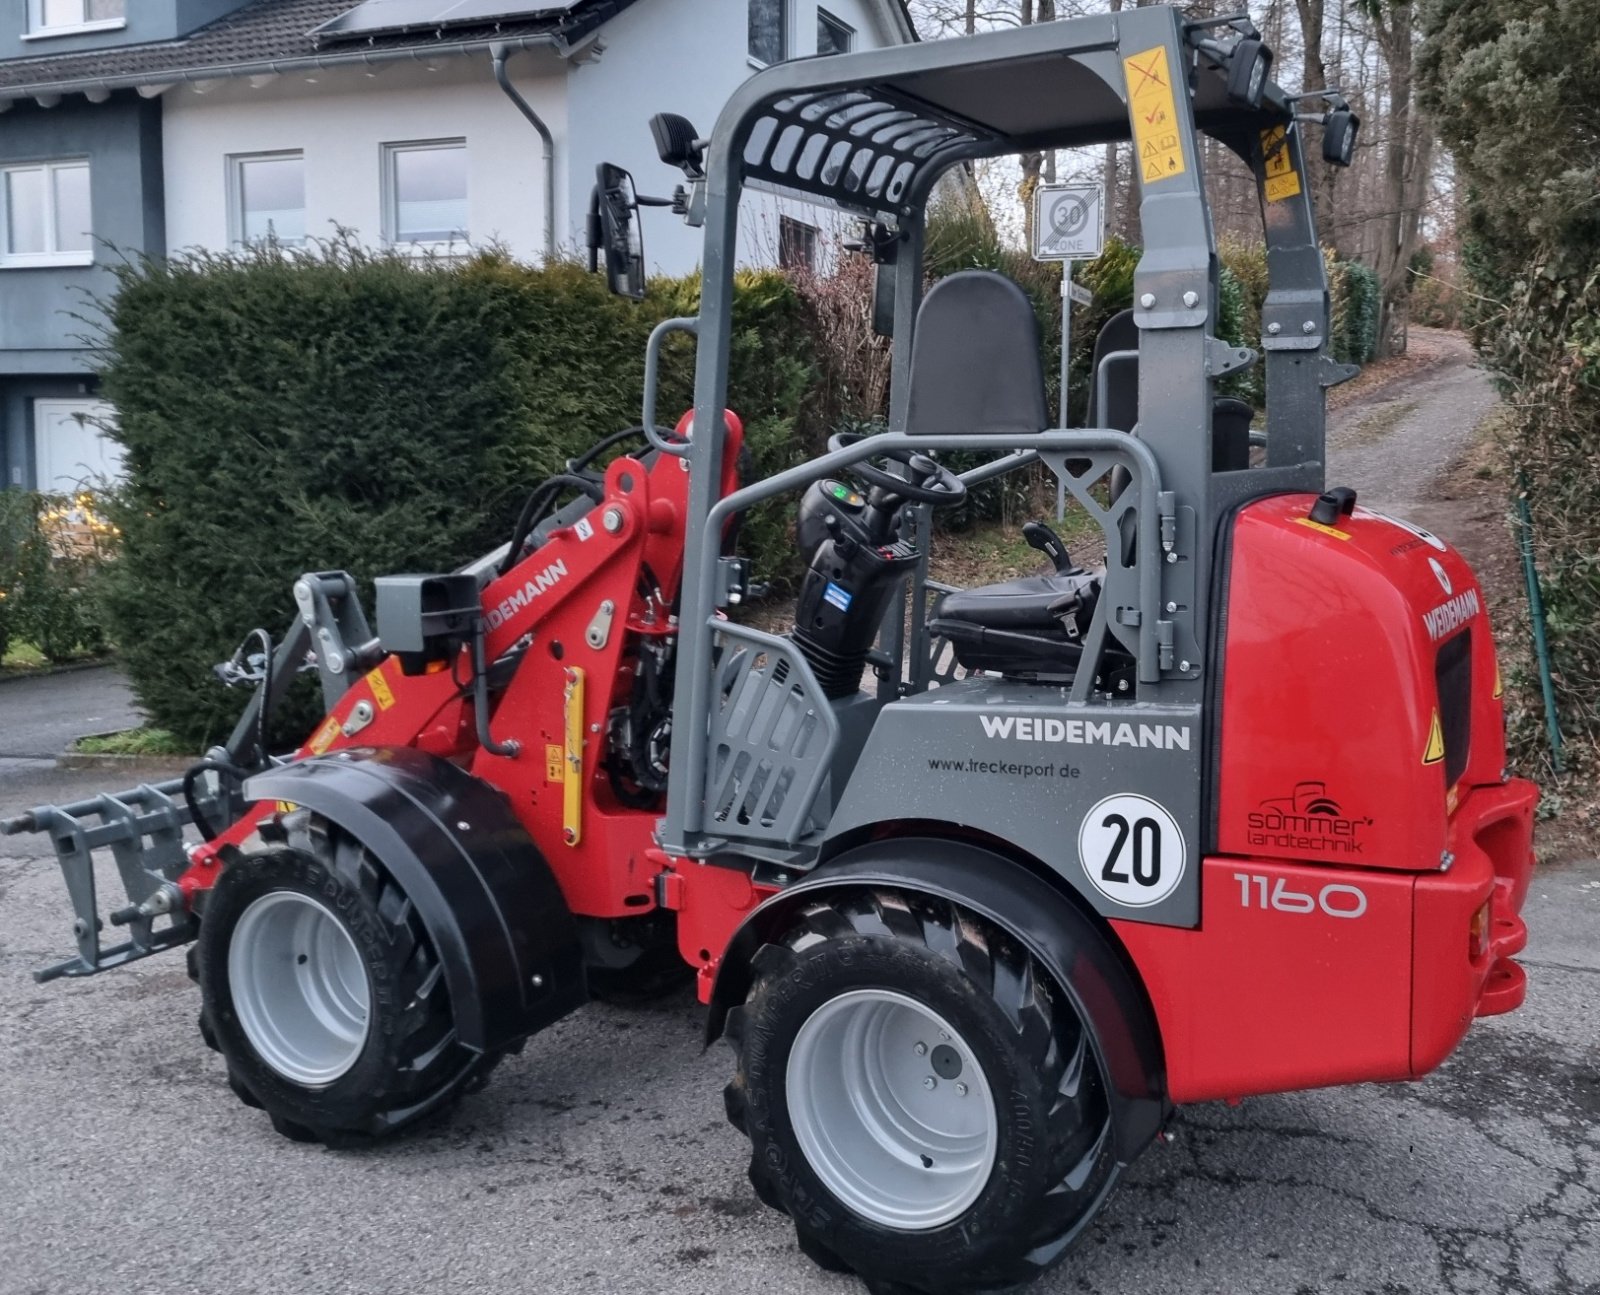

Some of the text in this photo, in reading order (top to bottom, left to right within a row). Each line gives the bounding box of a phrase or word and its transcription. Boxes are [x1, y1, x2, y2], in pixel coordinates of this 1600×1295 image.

[1057, 206, 1082, 226] 30
[1054, 240, 1084, 251] ZONE
[482, 558, 568, 634] IDEMANN
[1422, 587, 1480, 641] WEIDEMANN
[979, 715, 1190, 751] WEIDEMANN
[1100, 813, 1162, 887] 20
[1247, 830, 1364, 853] landtechnik
[1233, 872, 1368, 919] 1160
